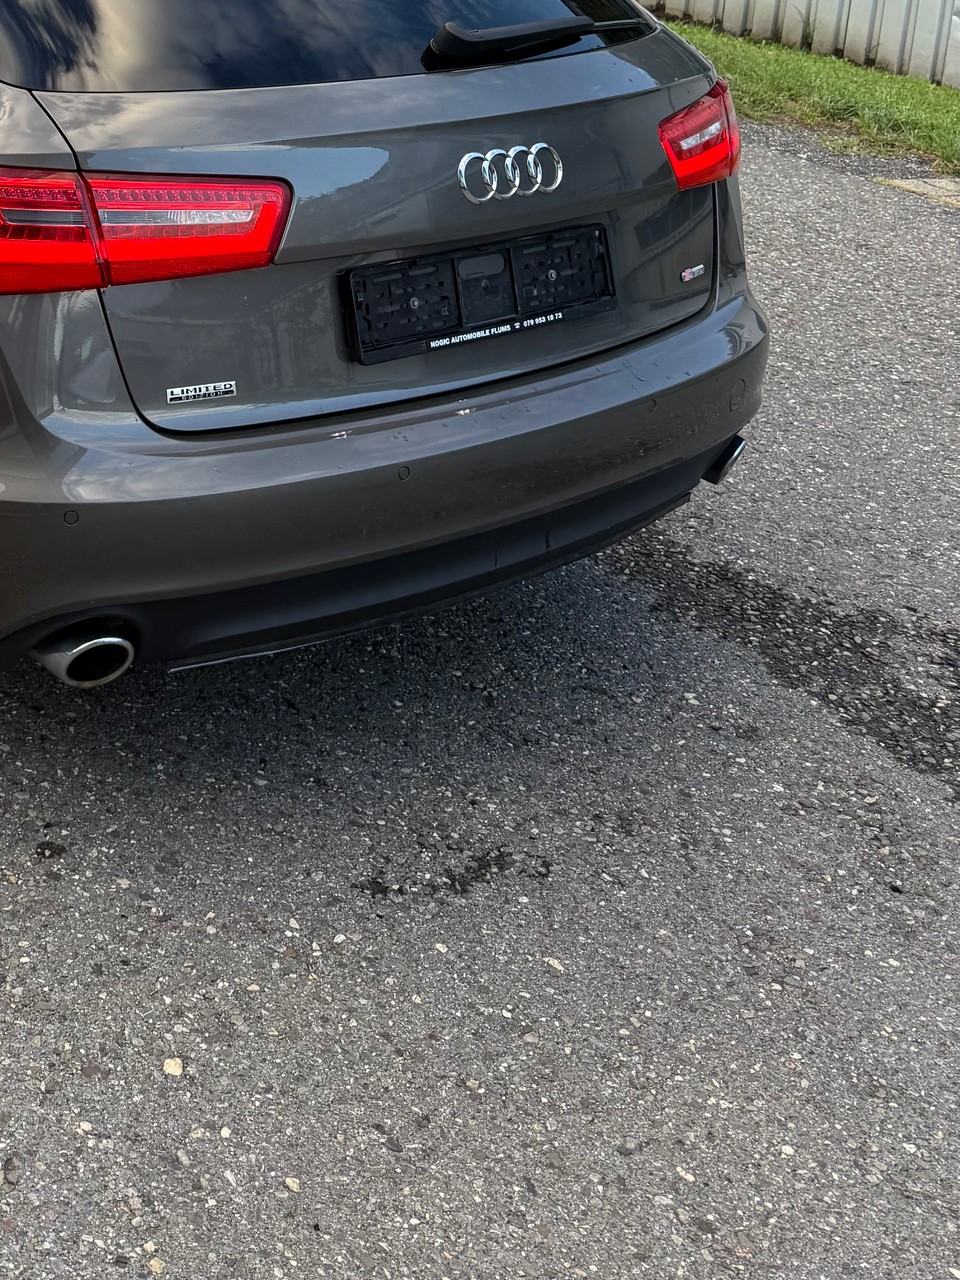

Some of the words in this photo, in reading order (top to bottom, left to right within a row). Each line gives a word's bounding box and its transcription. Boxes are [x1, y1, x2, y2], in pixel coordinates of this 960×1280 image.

[451, 328, 490, 343] AUTOMOBILE
[490, 324, 511, 335] FLUMS
[523, 319, 534, 327] 079
[170, 383, 233, 396] LIMITED
